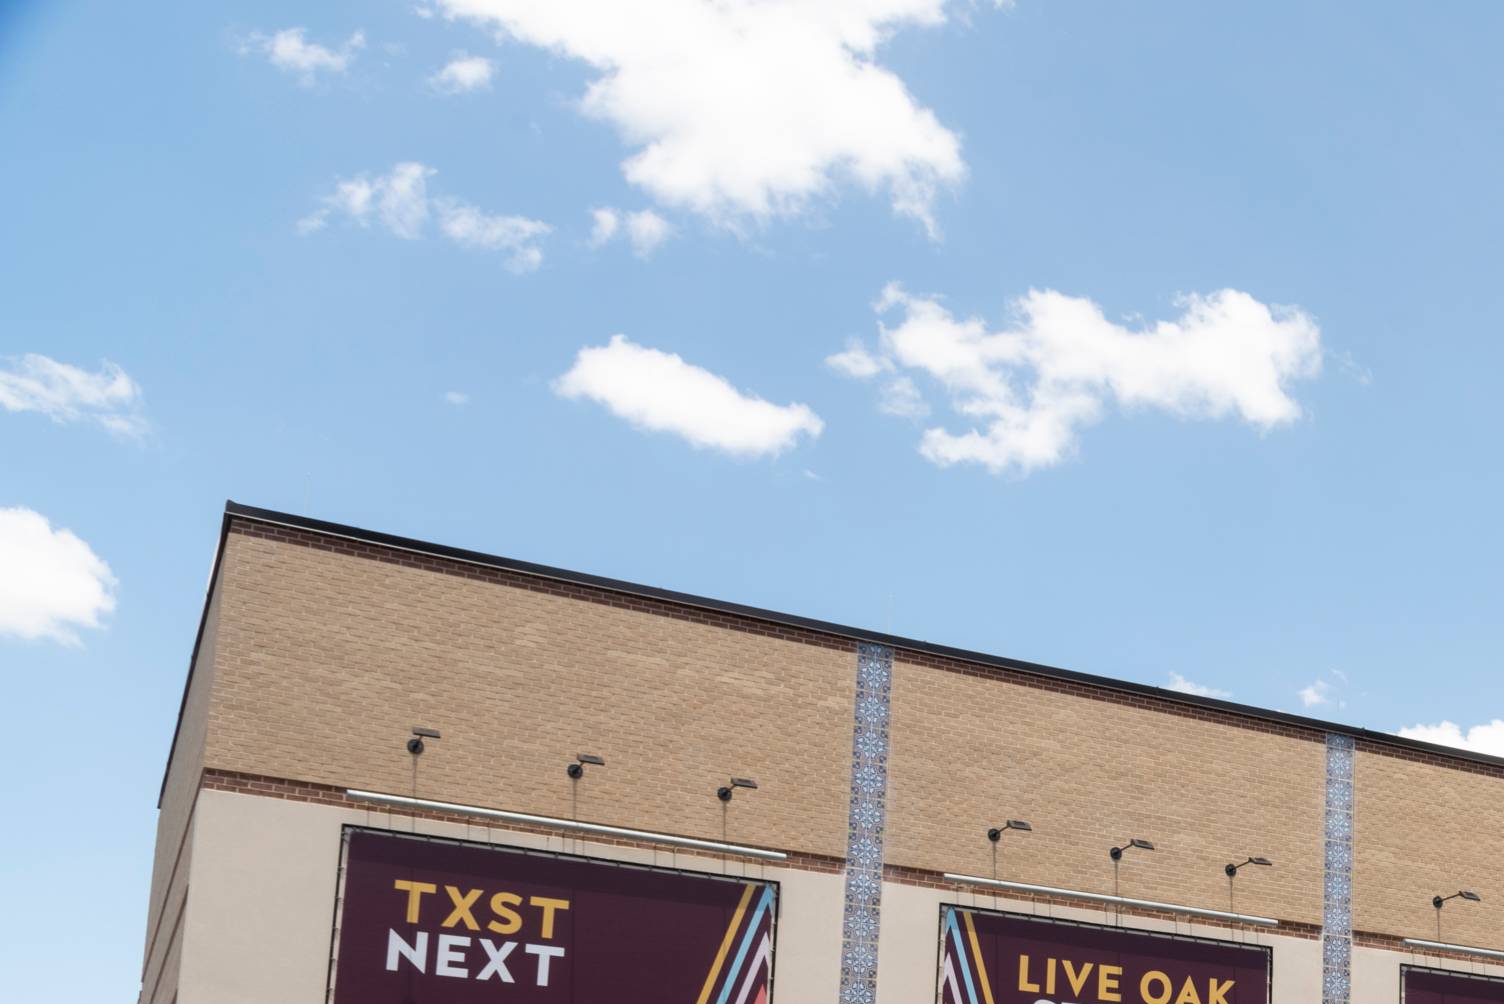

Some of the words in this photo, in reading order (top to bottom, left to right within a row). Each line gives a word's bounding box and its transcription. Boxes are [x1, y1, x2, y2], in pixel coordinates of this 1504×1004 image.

[394, 879, 570, 939] TXST
[386, 927, 566, 987] NEXT
[1018, 954, 1123, 1003] LIVE
